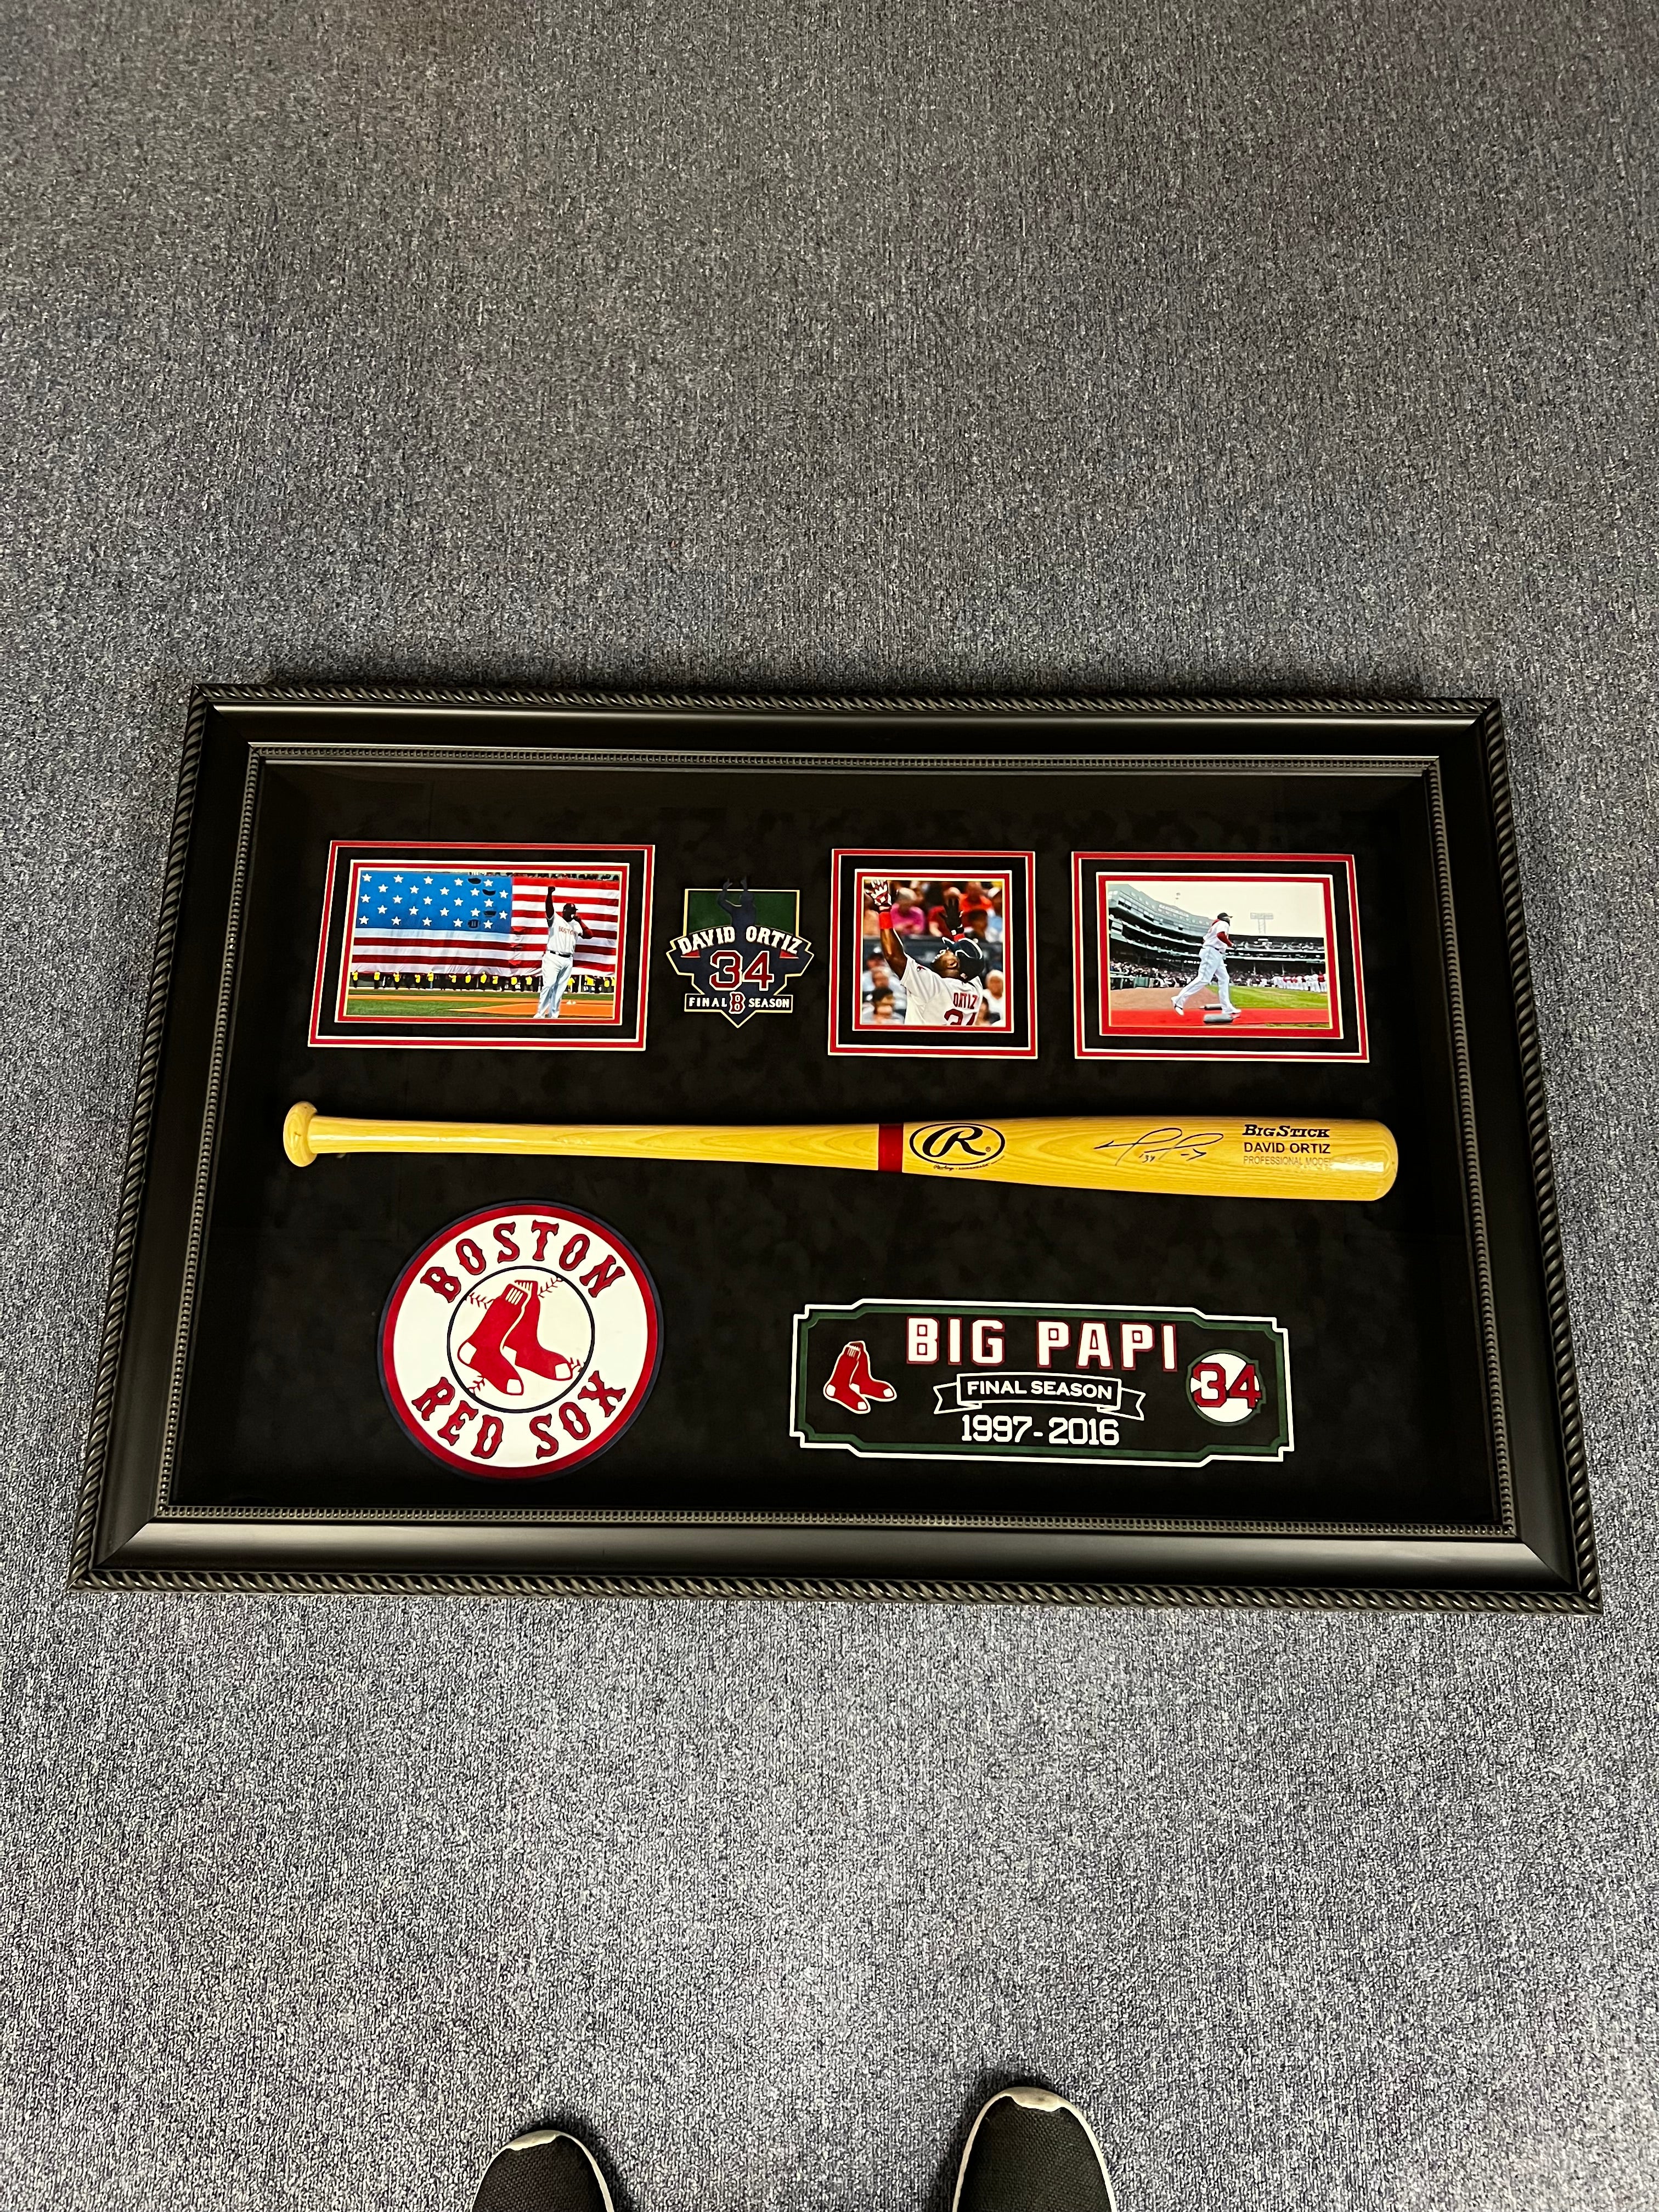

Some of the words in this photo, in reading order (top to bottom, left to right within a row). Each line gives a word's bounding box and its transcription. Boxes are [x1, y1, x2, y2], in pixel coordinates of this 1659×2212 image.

[677, 926, 736, 955] DAVID
[746, 926, 803, 954] ORTIZ
[709, 950, 775, 991] 34
[689, 997, 727, 1007] FINAL
[748, 998, 790, 1008] SEASON
[953, 992, 978, 1009] ORTIZ
[1243, 1155, 1303, 1166] PROFESSIONAL
[1244, 1142, 1285, 1153] DAVID
[1289, 1143, 1331, 1154] ORTIZ
[420, 1220, 626, 1304] BOSTON
[906, 1317, 1005, 1367] BIG
[1036, 1319, 1178, 1372] PAPI
[967, 1380, 1027, 1395] FINAL
[1030, 1381, 1112, 1400] SEASON
[1192, 1362, 1262, 1409] 34
[411, 1376, 504, 1460] RED
[529, 1370, 627, 1460] SOX
